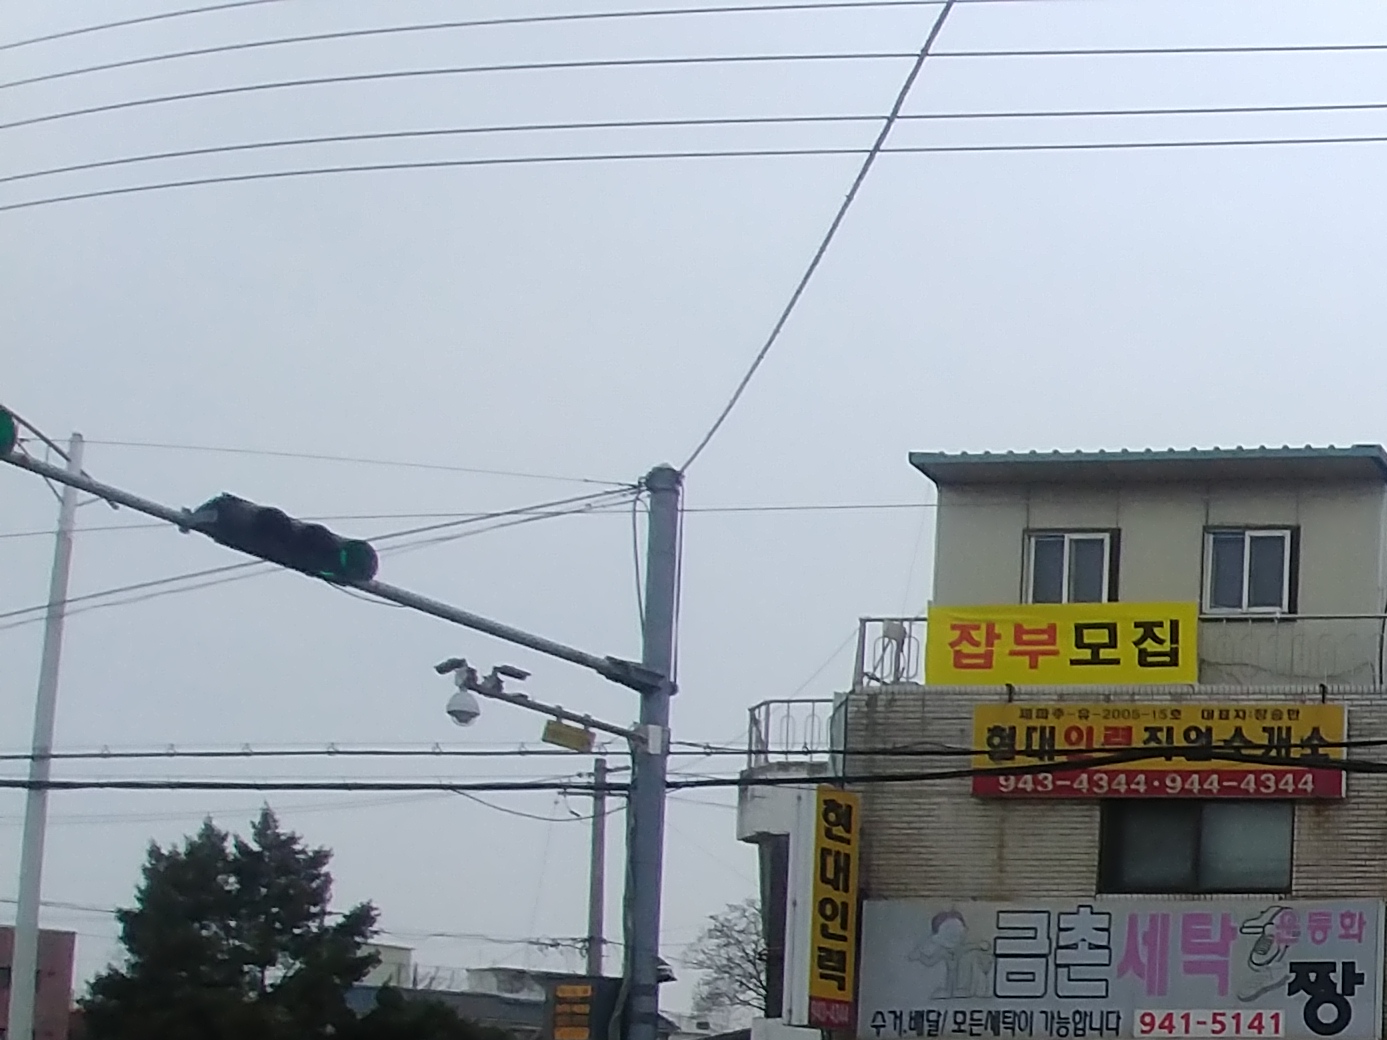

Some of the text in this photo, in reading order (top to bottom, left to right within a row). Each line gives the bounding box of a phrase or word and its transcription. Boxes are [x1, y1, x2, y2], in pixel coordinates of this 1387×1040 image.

[948, 619, 1180, 670] 잡부모집
[818, 798, 854, 992] 현대인력
[1275, 909, 1367, 945] 운동화
[1139, 1011, 1281, 1035] 941-5141
[1287, 961, 1365, 1036] 짱
